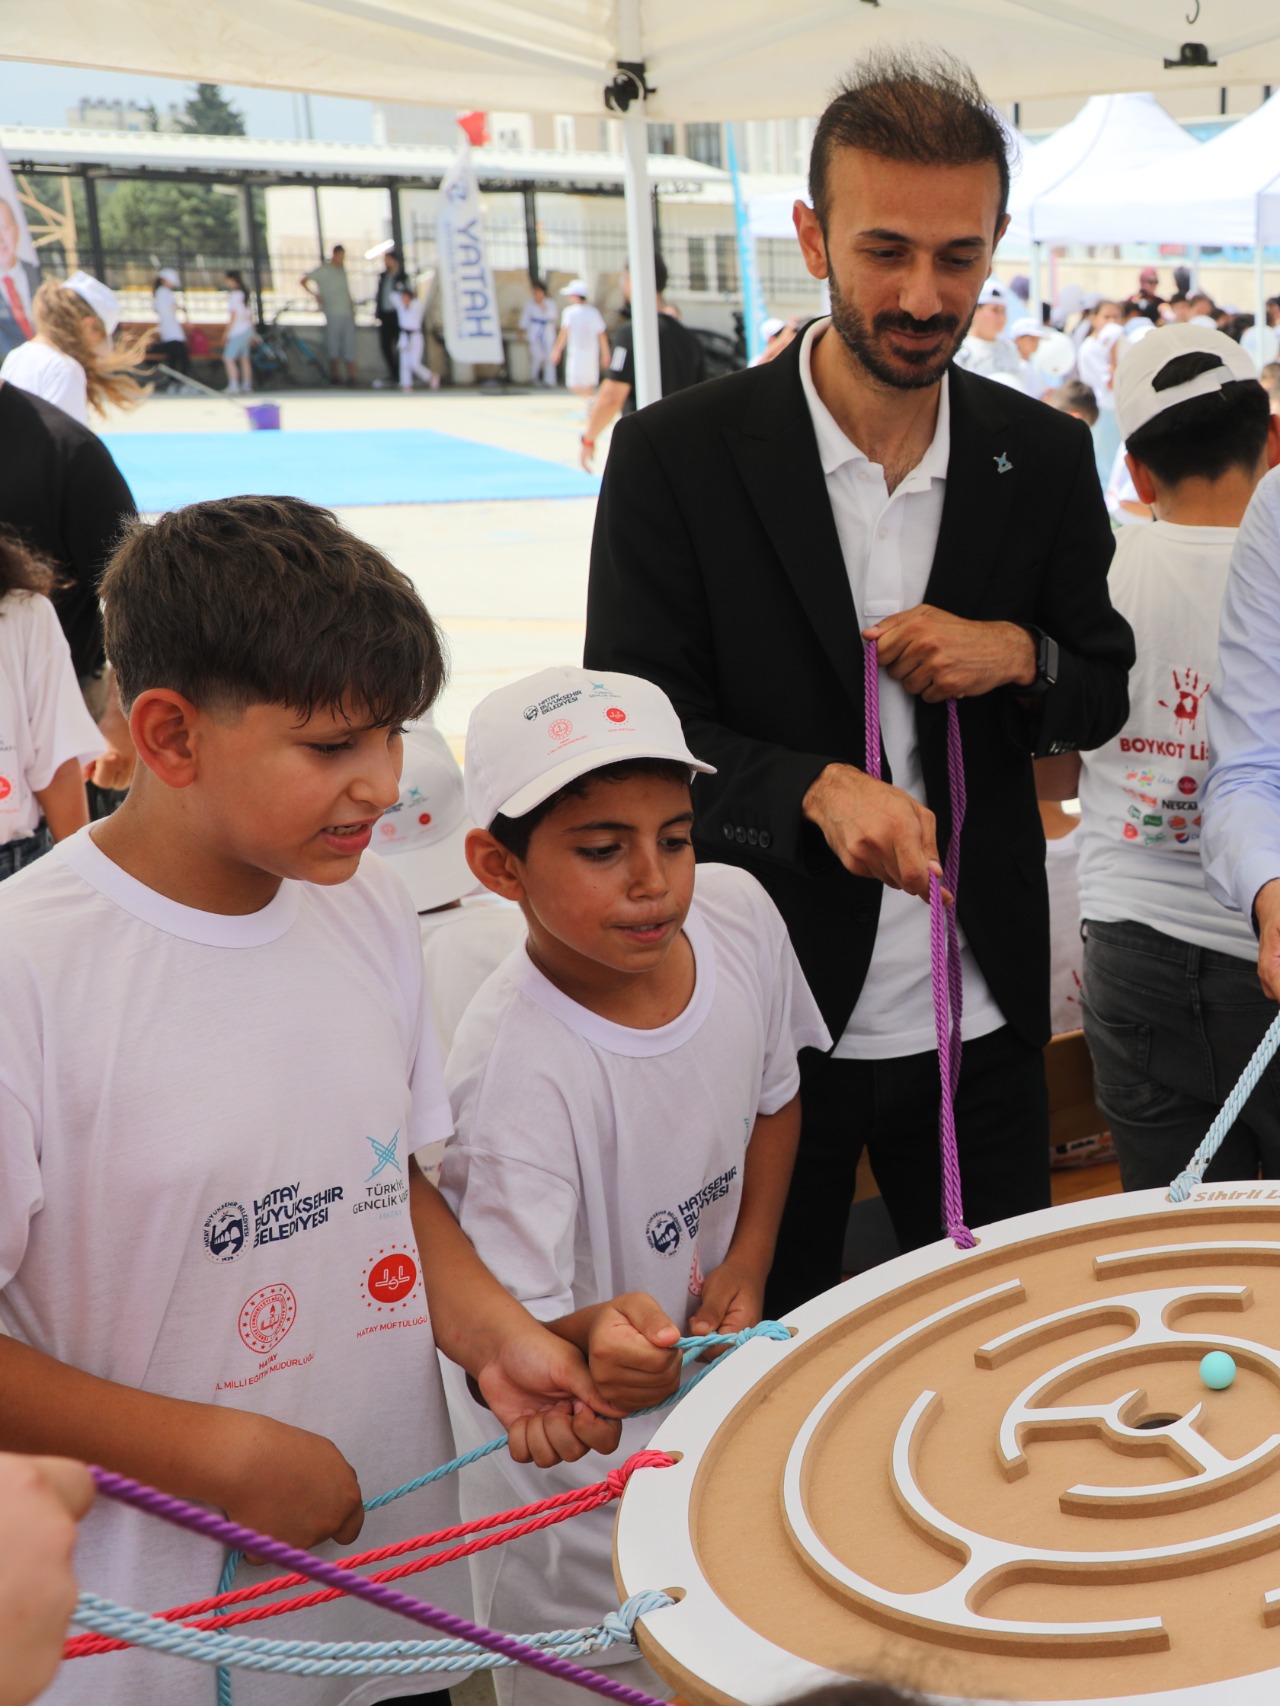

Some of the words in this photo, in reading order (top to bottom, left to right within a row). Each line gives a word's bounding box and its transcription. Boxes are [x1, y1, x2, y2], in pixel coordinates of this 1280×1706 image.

[1120, 738, 1185, 759] BOYKOT
[253, 1181, 301, 1216] HATAY
[353, 1195, 397, 1214] GENÇLİK
[1193, 1189, 1263, 1202] Sihirli
[357, 1325, 378, 1339] HATAY
